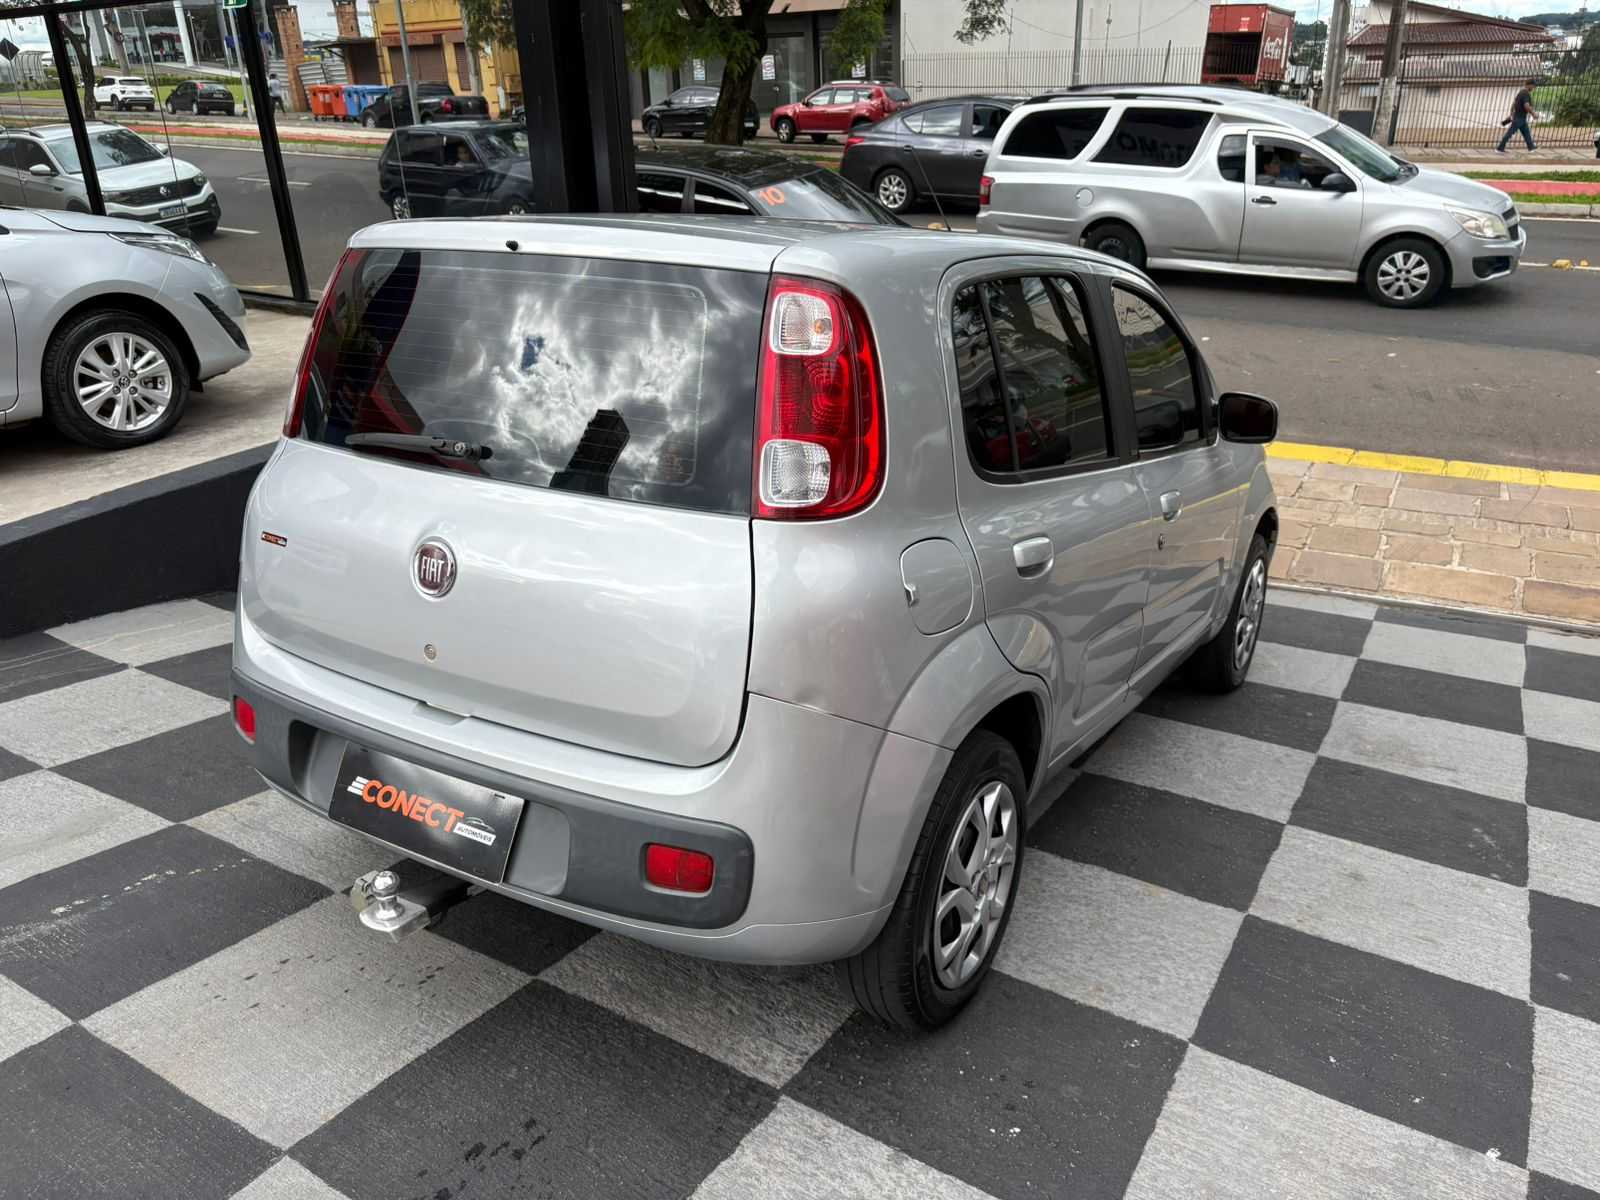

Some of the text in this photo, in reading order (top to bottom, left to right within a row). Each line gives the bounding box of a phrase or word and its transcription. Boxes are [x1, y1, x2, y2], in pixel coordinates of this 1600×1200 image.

[757, 187, 785, 206] 10
[421, 556, 445, 582] FIAT
[362, 779, 465, 833] CONECT
